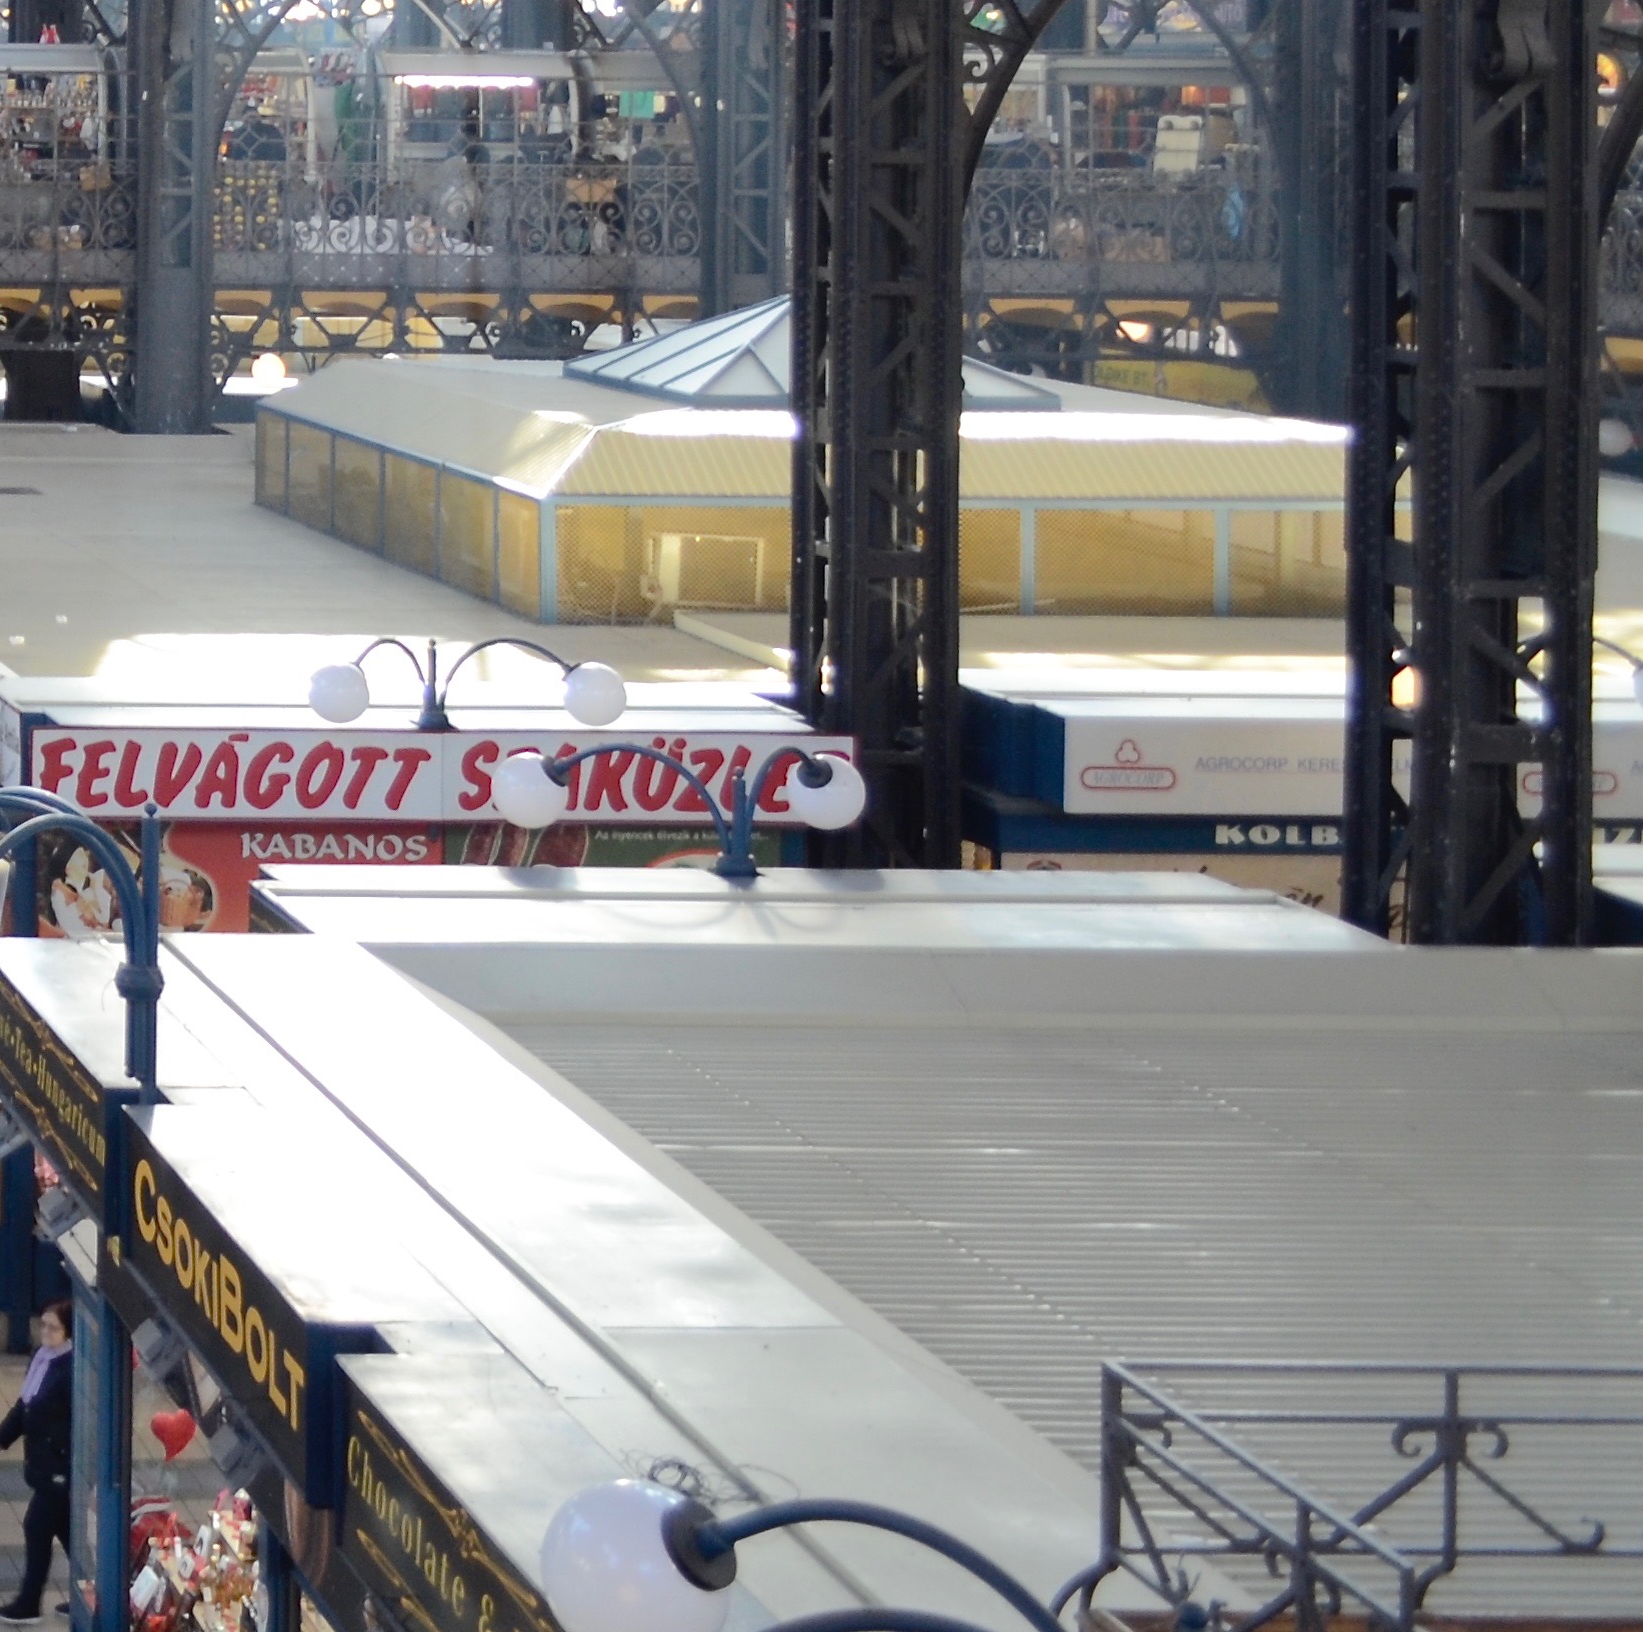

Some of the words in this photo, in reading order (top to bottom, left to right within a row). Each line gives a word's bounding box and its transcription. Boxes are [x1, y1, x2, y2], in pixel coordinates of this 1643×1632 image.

[39, 732, 433, 811] FELVÁGOTT
[457, 736, 851, 814] SAKÜZLE
[1195, 756, 1288, 773] AGROCORP
[240, 831, 429, 862] KABANOS
[1213, 822, 1340, 847] KOLB
[346, 1434, 467, 1618] Chocolate
